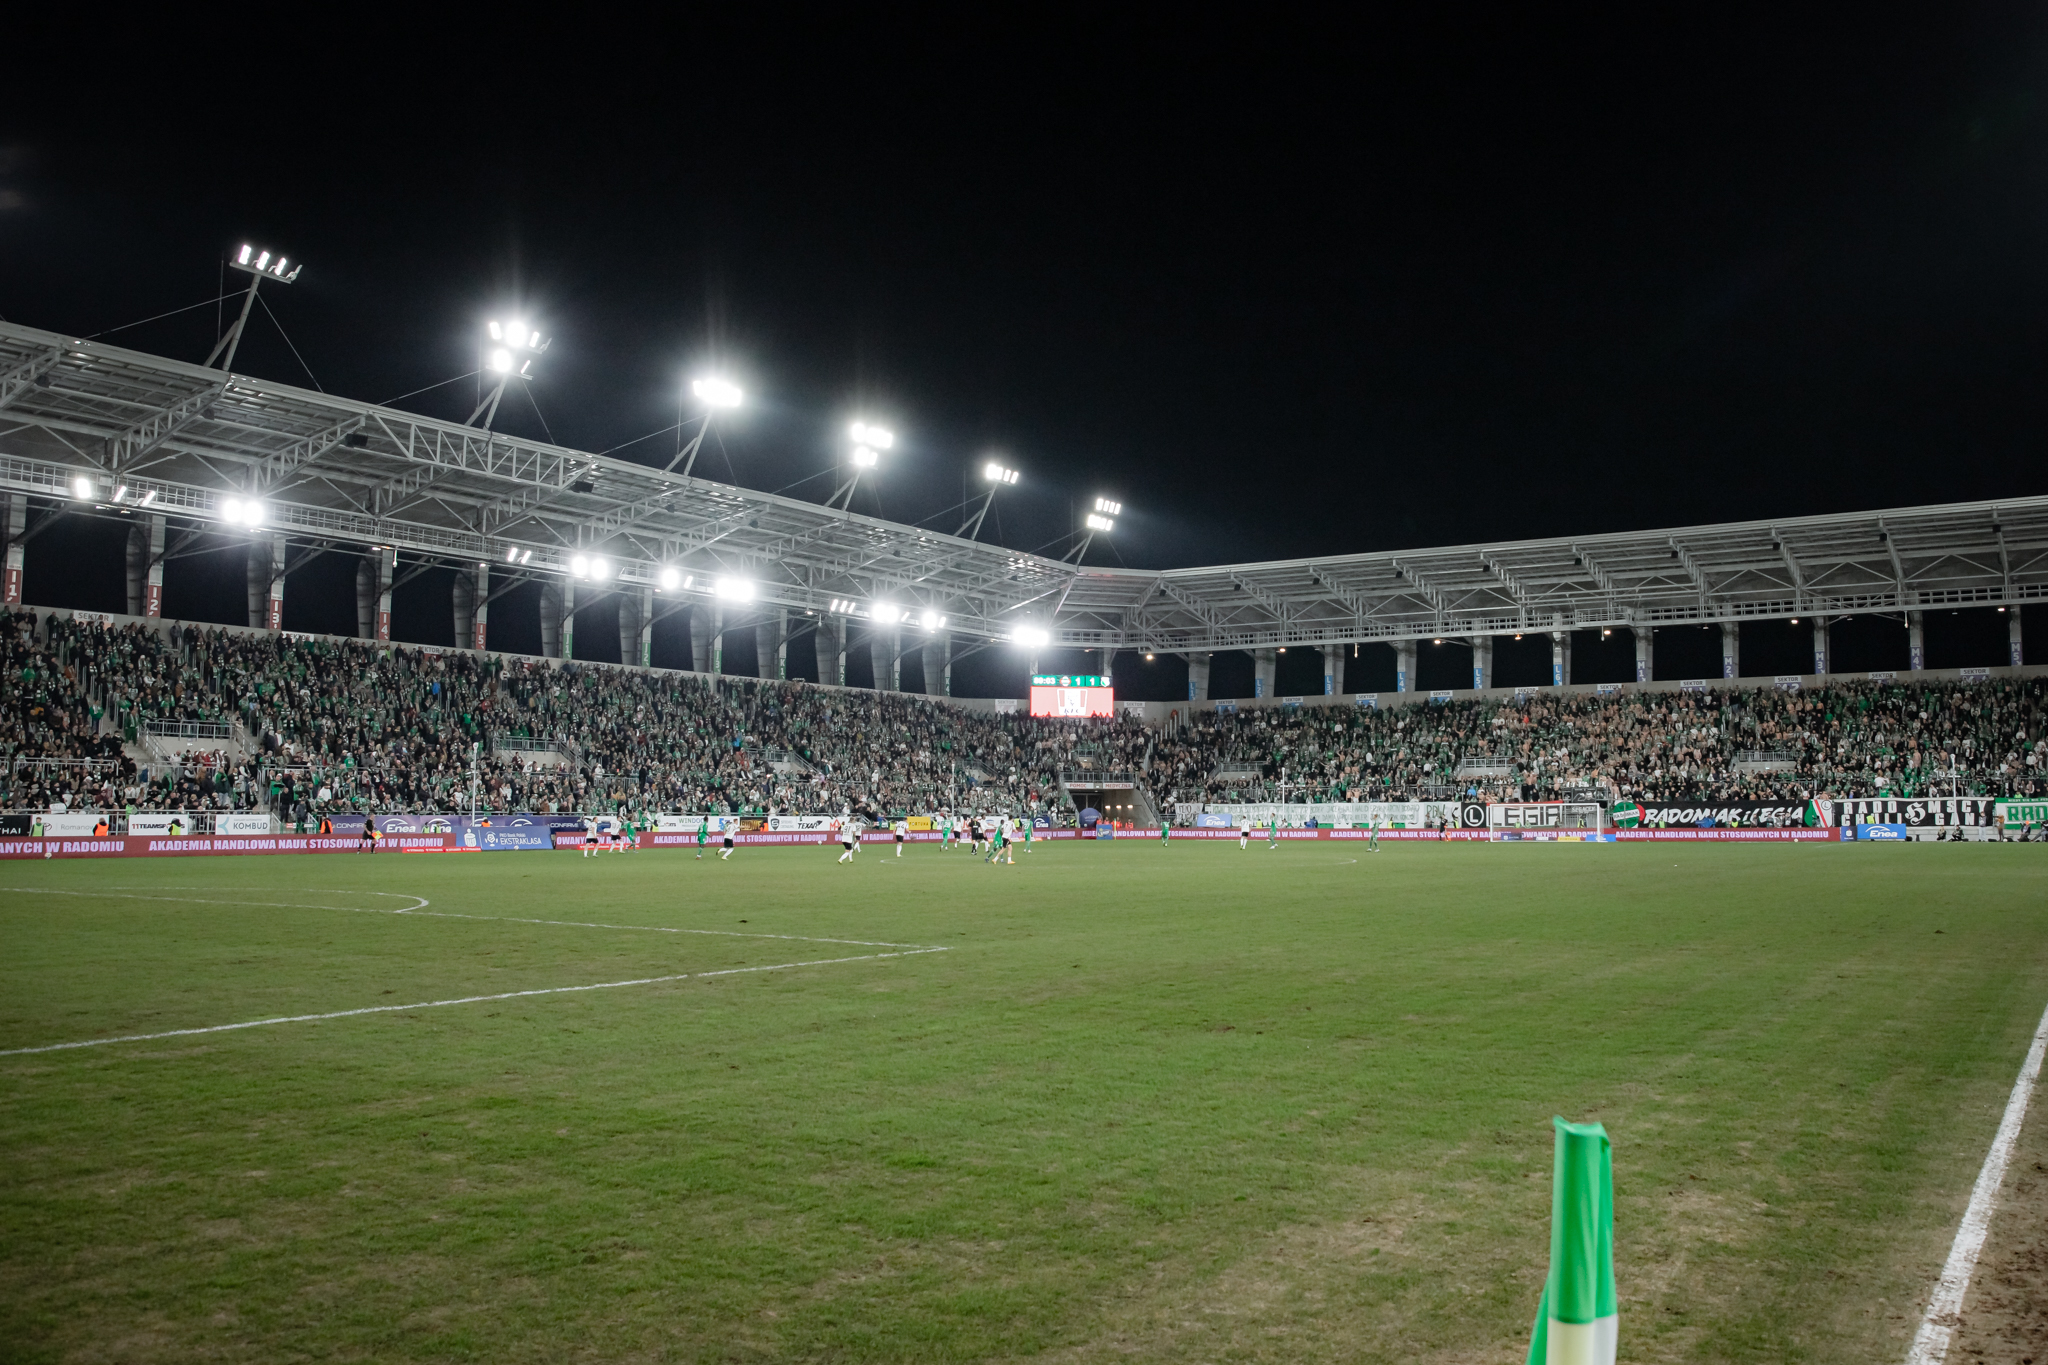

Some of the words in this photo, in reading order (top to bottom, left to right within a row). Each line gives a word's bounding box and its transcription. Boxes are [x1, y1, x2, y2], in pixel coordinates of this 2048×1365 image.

[78, 612, 110, 622] SEKTR
[1076, 676, 1080, 686] 1
[1090, 676, 1095, 686] 1
[1844, 801, 1897, 814] RADO
[1470, 808, 1478, 822] L
[1644, 808, 1742, 824] RADOMIAK
[233, 822, 268, 830] KOMBUD
[386, 822, 416, 832] Enea
[798, 822, 818, 830] TEXAR
[654, 836, 690, 844] AKADEMIA
[746, 834, 792, 842] STOSOWANYCH
[1870, 830, 1898, 838] Enea
[148, 840, 212, 851] AKADEMIA
[214, 840, 276, 850] HANDLOWA
[279, 839, 308, 850] NAUK
[388, 838, 402, 848] W
[402, 838, 443, 848] RADOMIU
[500, 836, 542, 846] EKSTRAKLASA
[46, 842, 60, 853] W
[63, 840, 124, 853] RADOMIU
